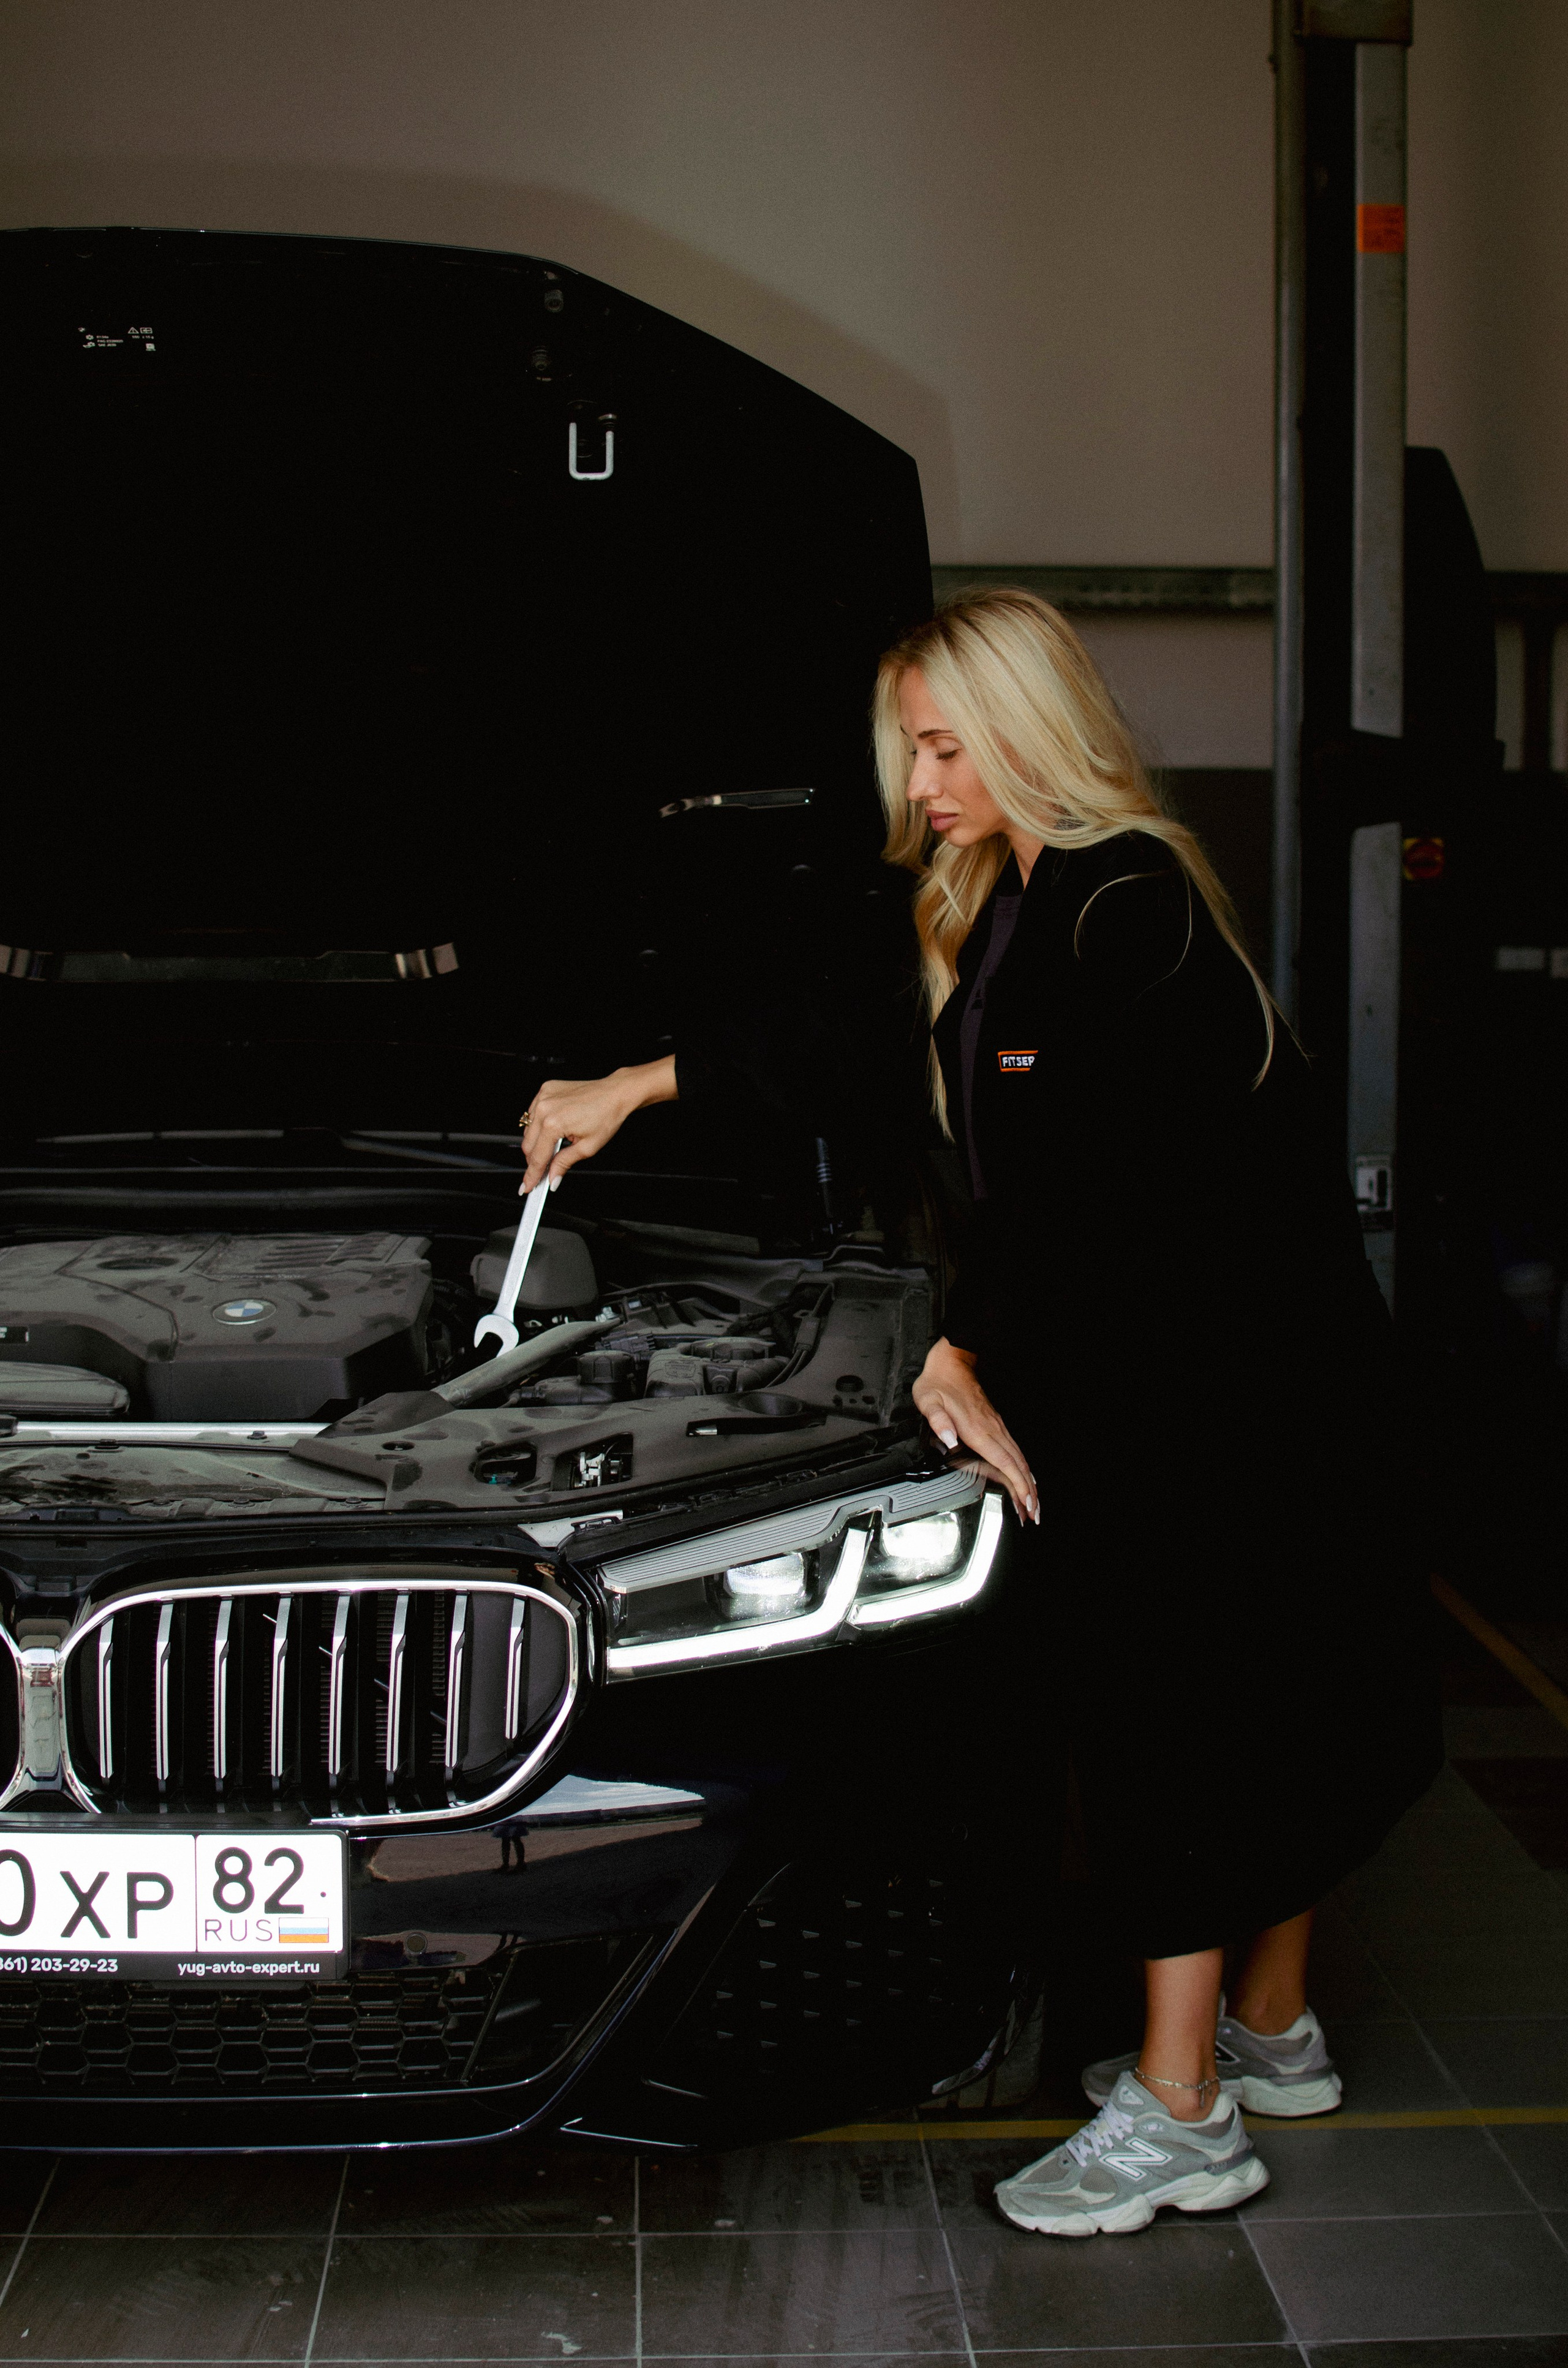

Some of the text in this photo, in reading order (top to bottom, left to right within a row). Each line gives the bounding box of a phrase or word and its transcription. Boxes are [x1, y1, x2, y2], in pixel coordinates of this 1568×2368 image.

[1002, 1056, 1035, 1067] FITSEP
[213, 1847, 304, 1914] 82
[205, 1919, 273, 1942] RUS
[31, 1958, 118, 1972] 203-29-23
[177, 1961, 320, 1976] yug-avto-expert.ru
